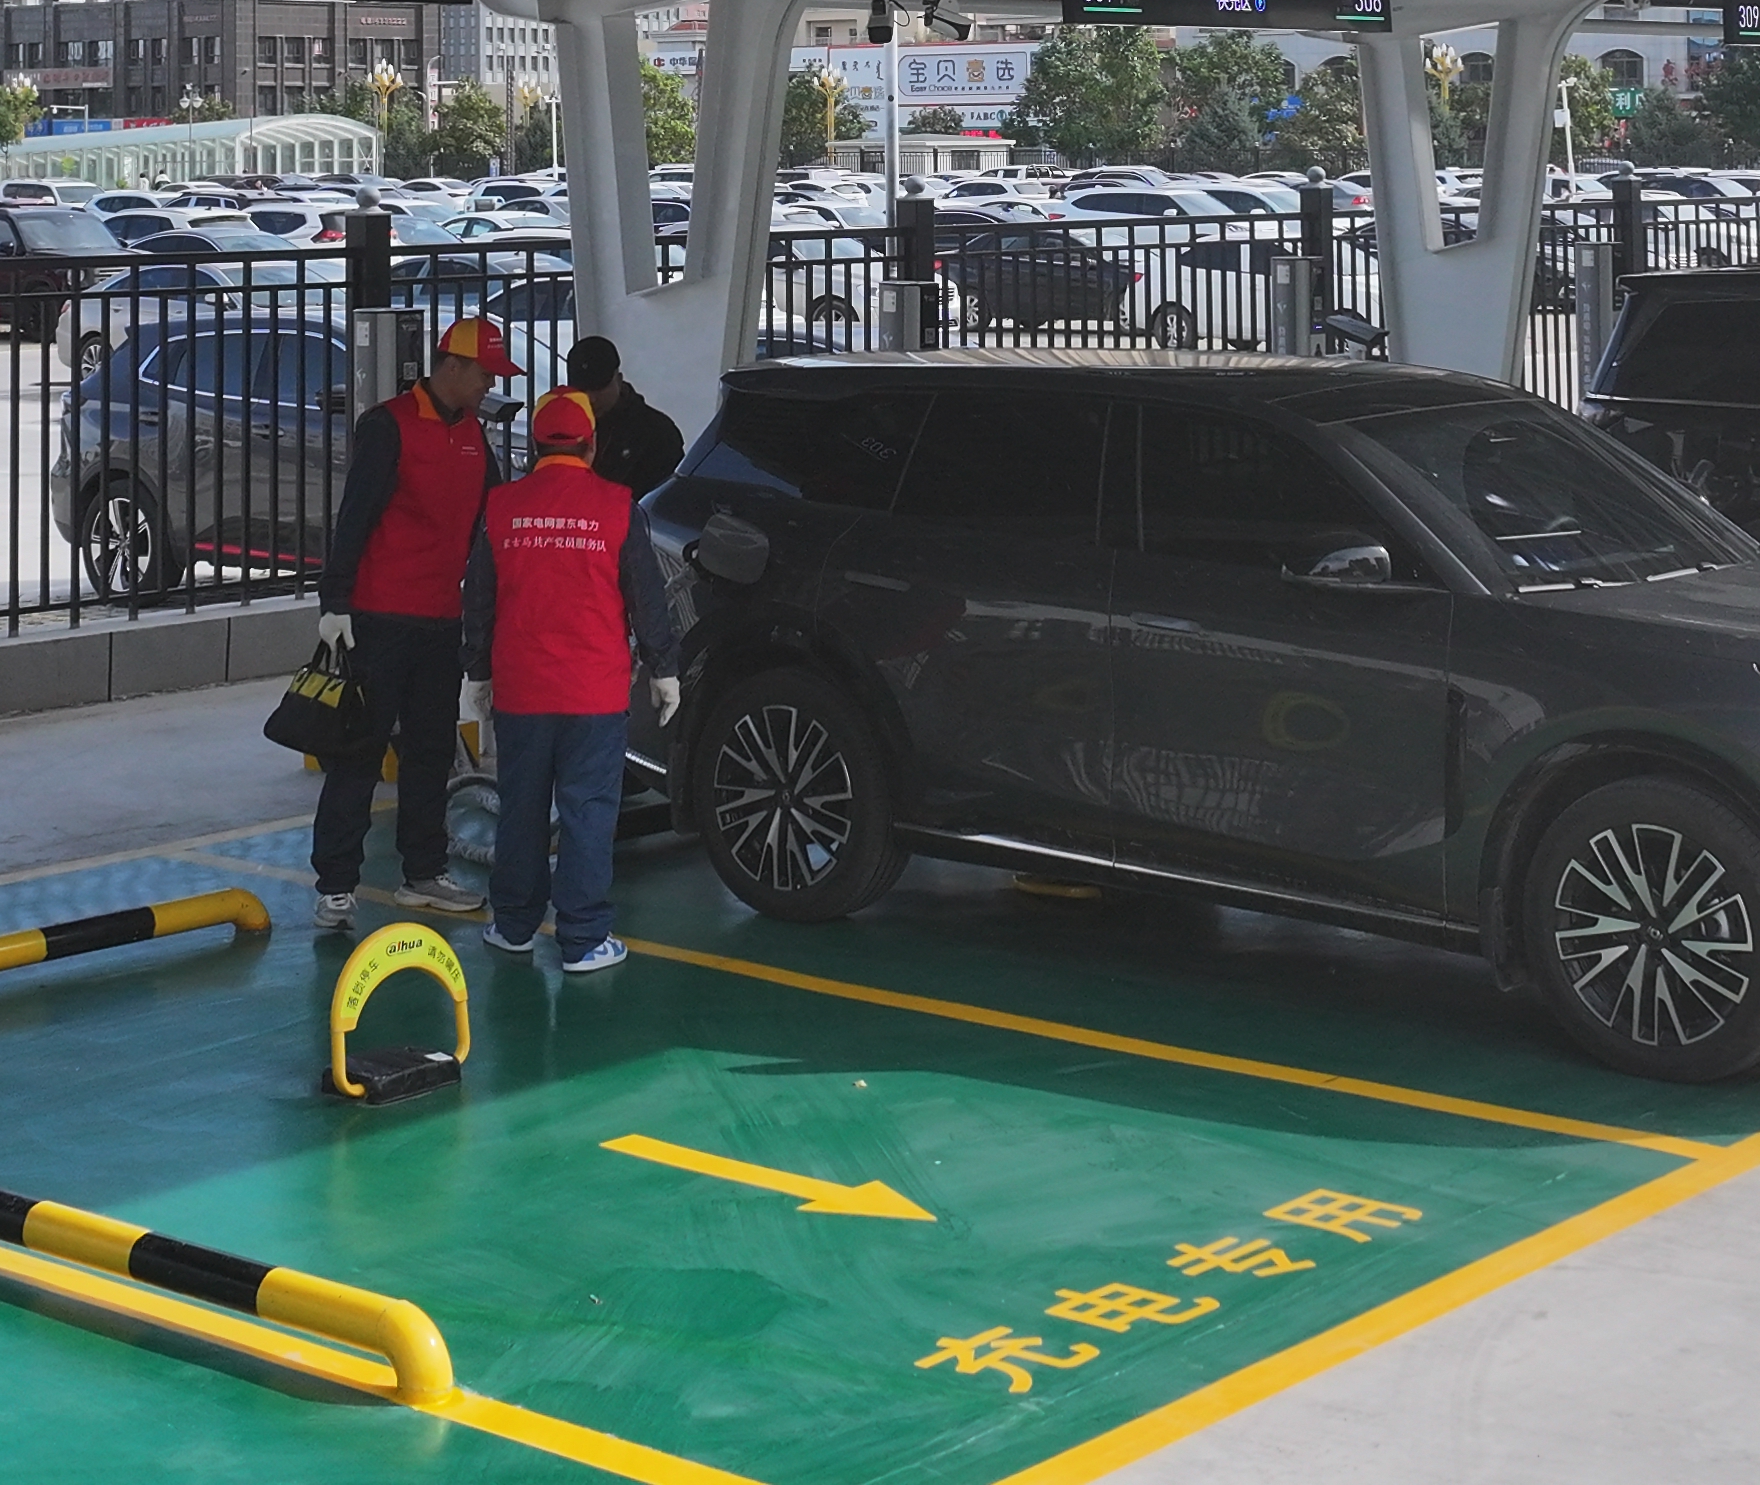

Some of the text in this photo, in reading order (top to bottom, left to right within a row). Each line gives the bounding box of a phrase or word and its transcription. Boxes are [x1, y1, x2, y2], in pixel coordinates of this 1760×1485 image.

[1738, 5, 1760, 28] 309
[511, 517, 600, 531] 国家电网蒙东电力
[502, 535, 608, 552] 蒙古马共产党员服务队
[913, 1186, 1423, 1393] 充电专用
